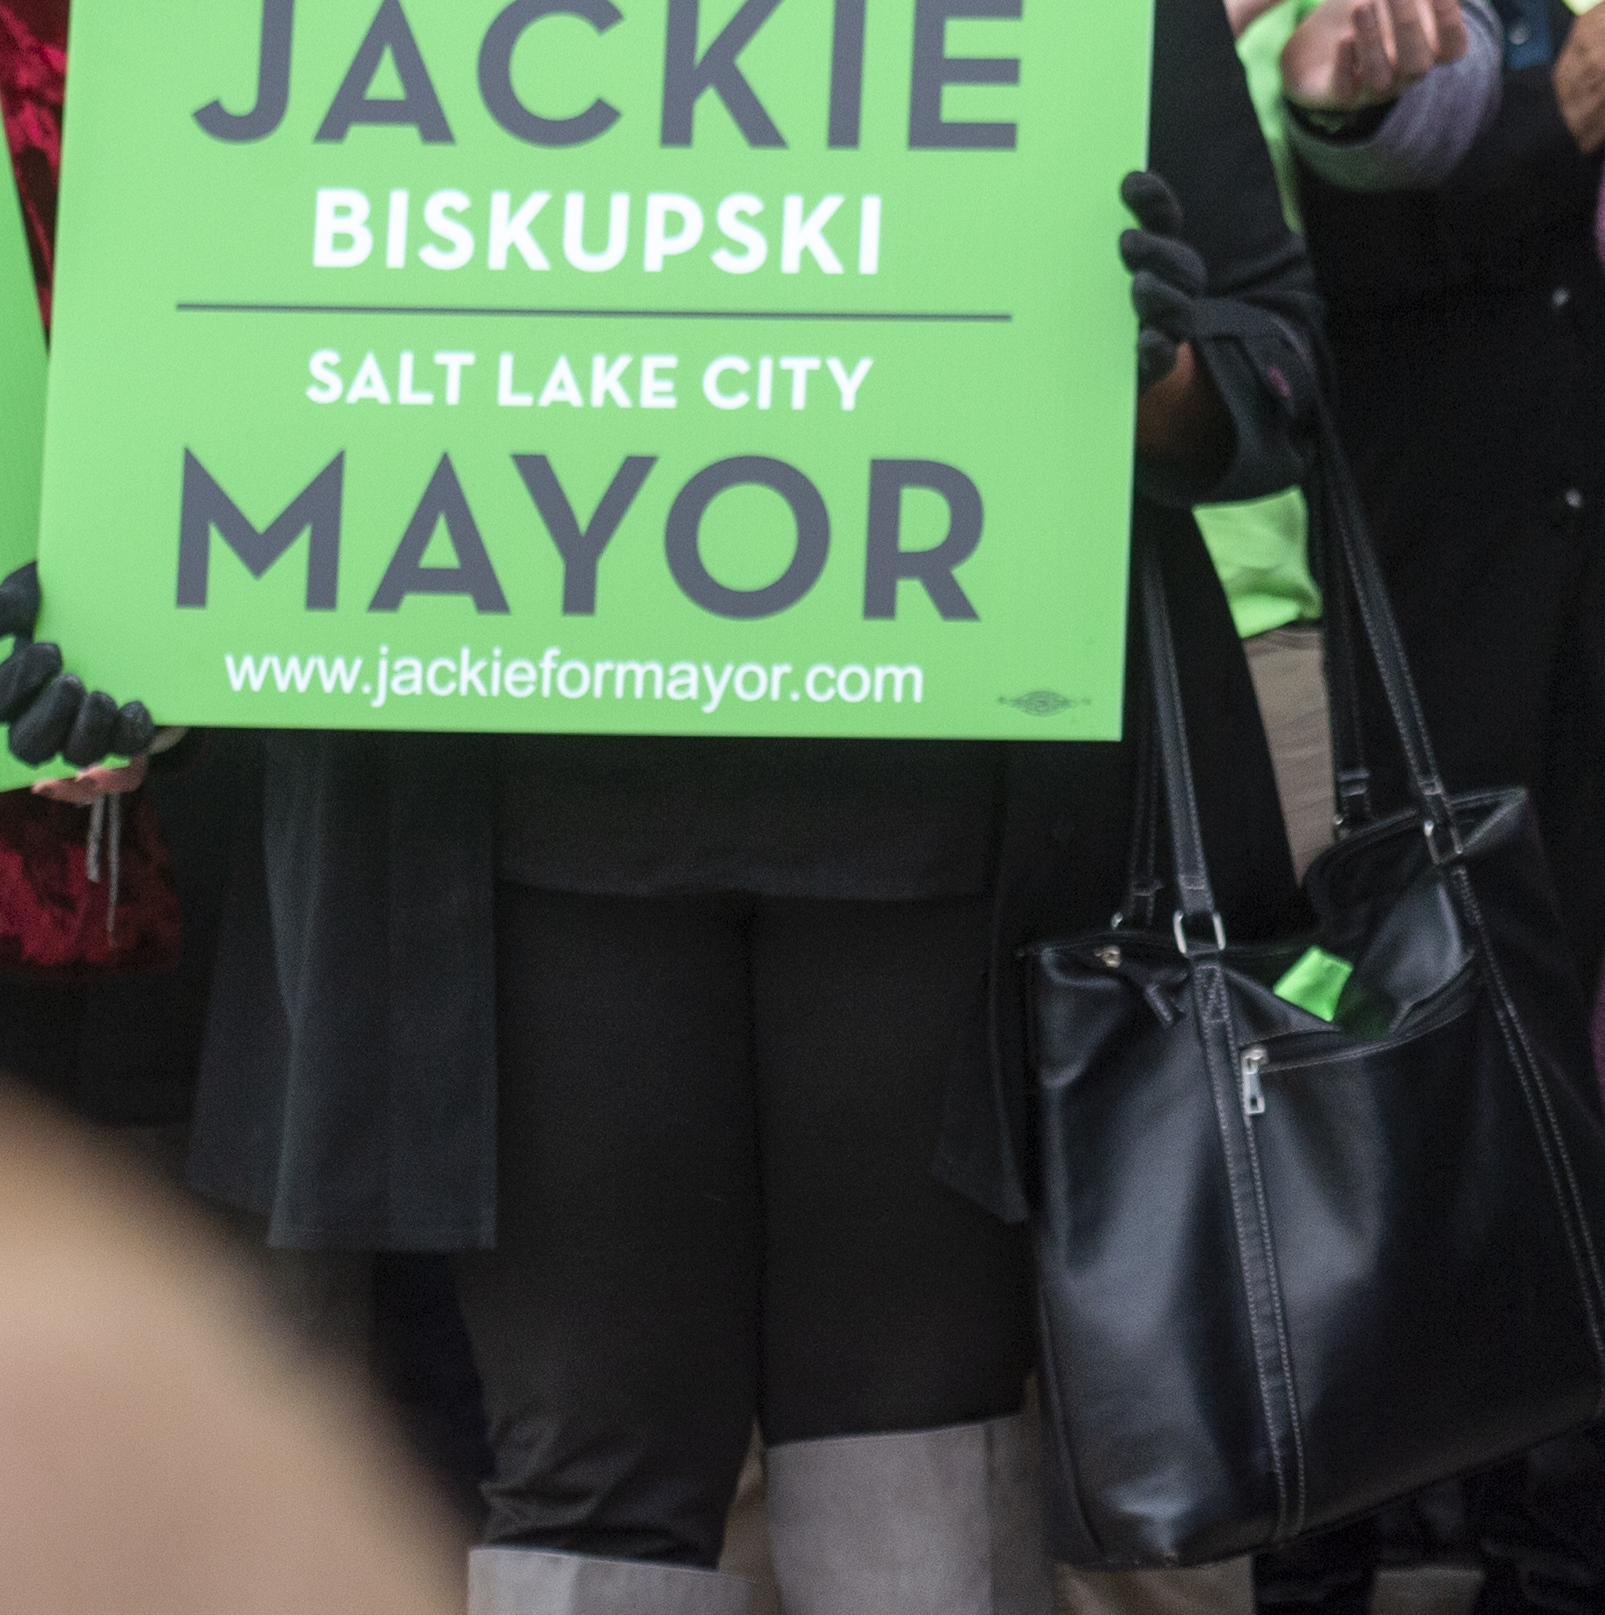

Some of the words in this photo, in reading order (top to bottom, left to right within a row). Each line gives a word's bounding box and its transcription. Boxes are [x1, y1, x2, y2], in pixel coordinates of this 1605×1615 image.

[312, 188, 882, 275] BISKUPSKI
[306, 349, 476, 406] SALT
[497, 353, 679, 409] LAKE
[702, 356, 874, 411] CITY
[175, 446, 985, 621] MAYOR
[224, 644, 924, 714] www.jackieformayor.com
